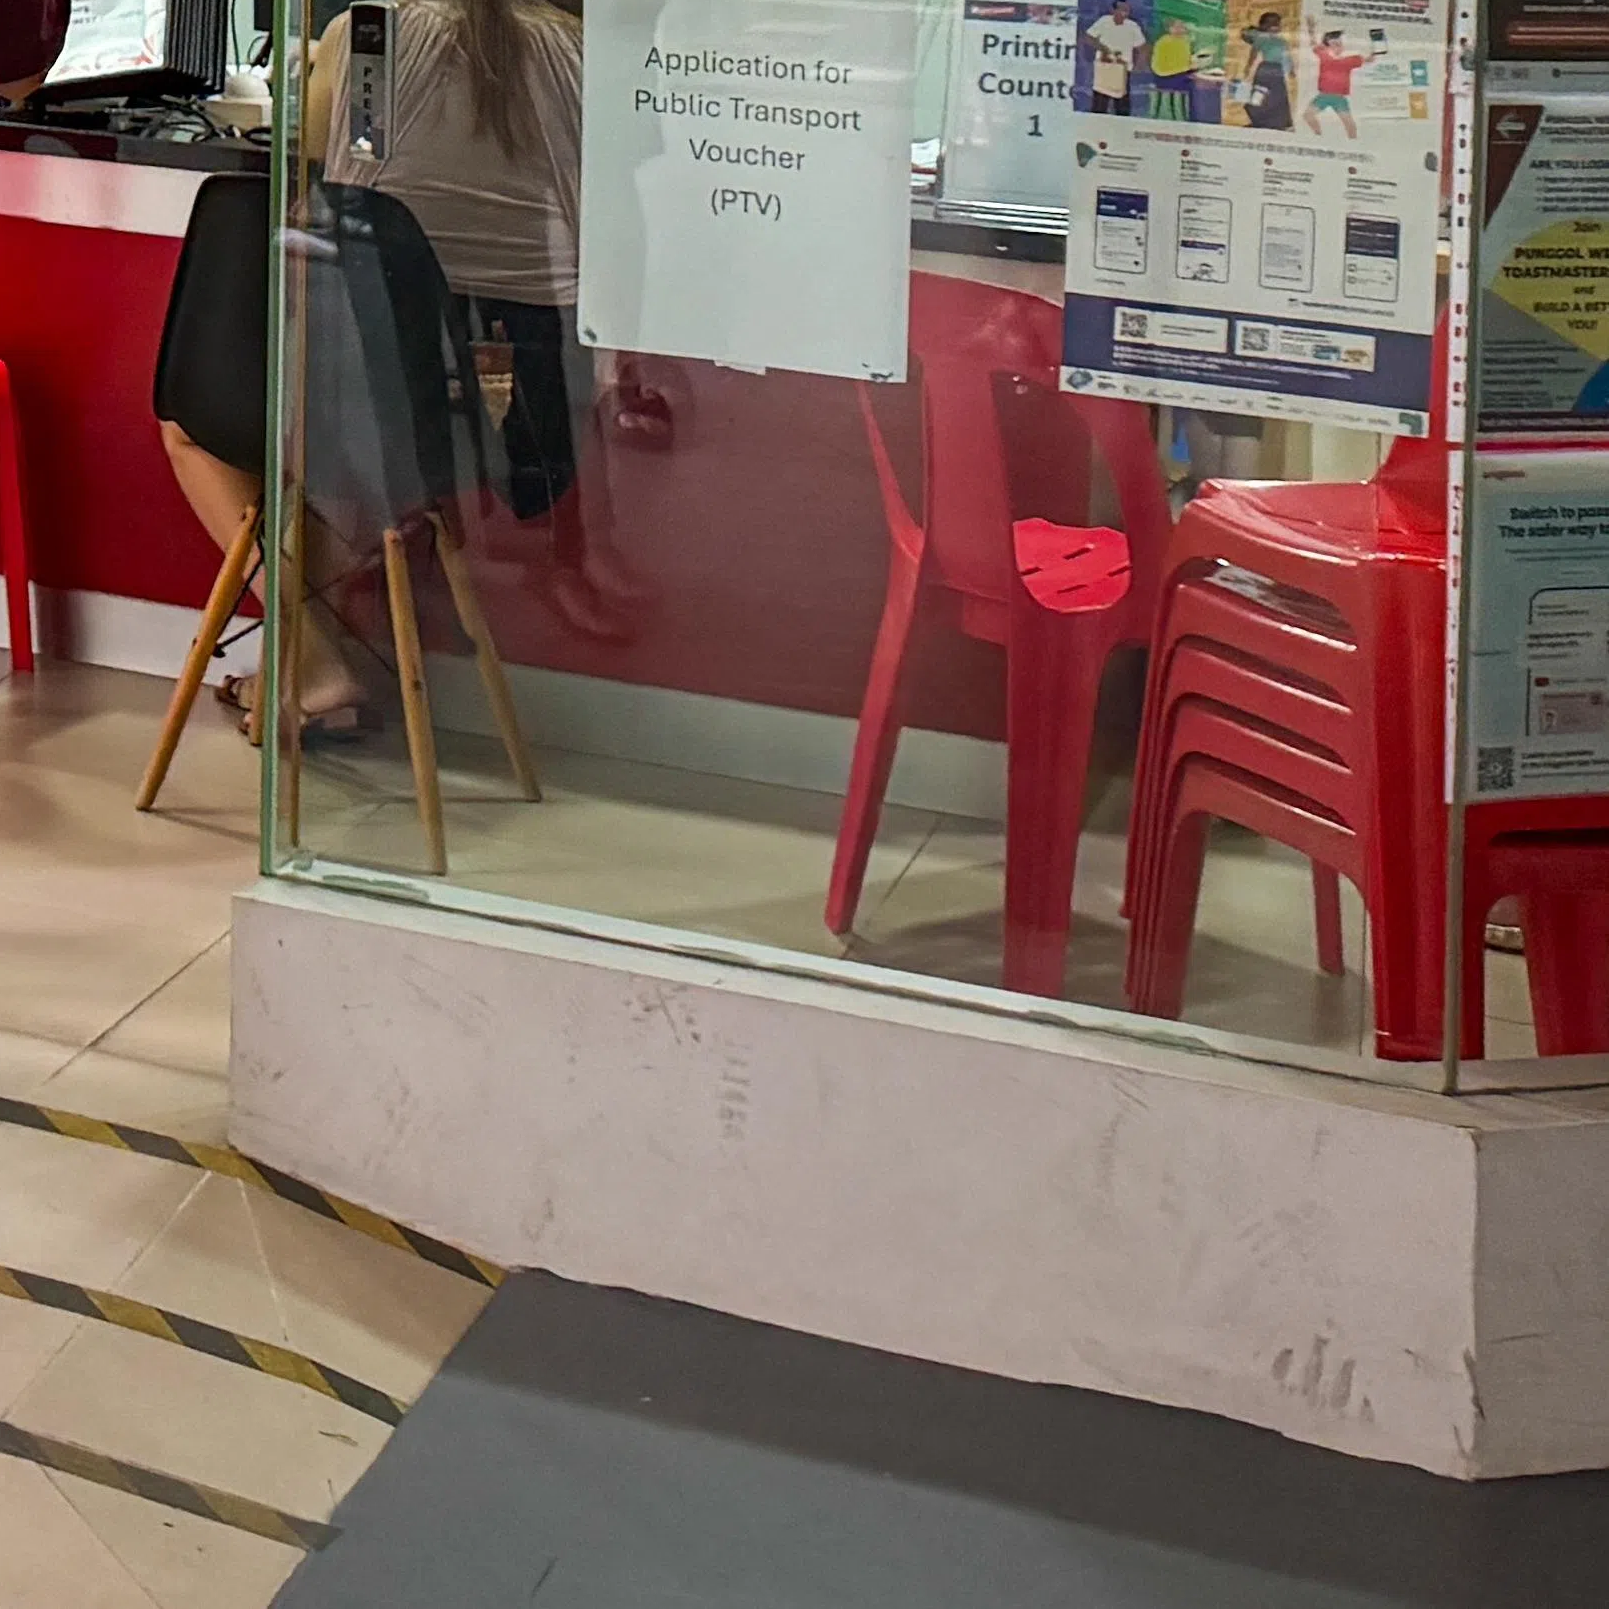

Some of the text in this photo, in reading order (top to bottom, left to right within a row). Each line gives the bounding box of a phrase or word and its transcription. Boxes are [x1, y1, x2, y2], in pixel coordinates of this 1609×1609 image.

[645, 46, 854, 84] Application for
[635, 89, 862, 132] Public Transport
[1027, 114, 1043, 137] 1
[689, 138, 807, 171] Voucher
[711, 188, 782, 221] (PTV)
